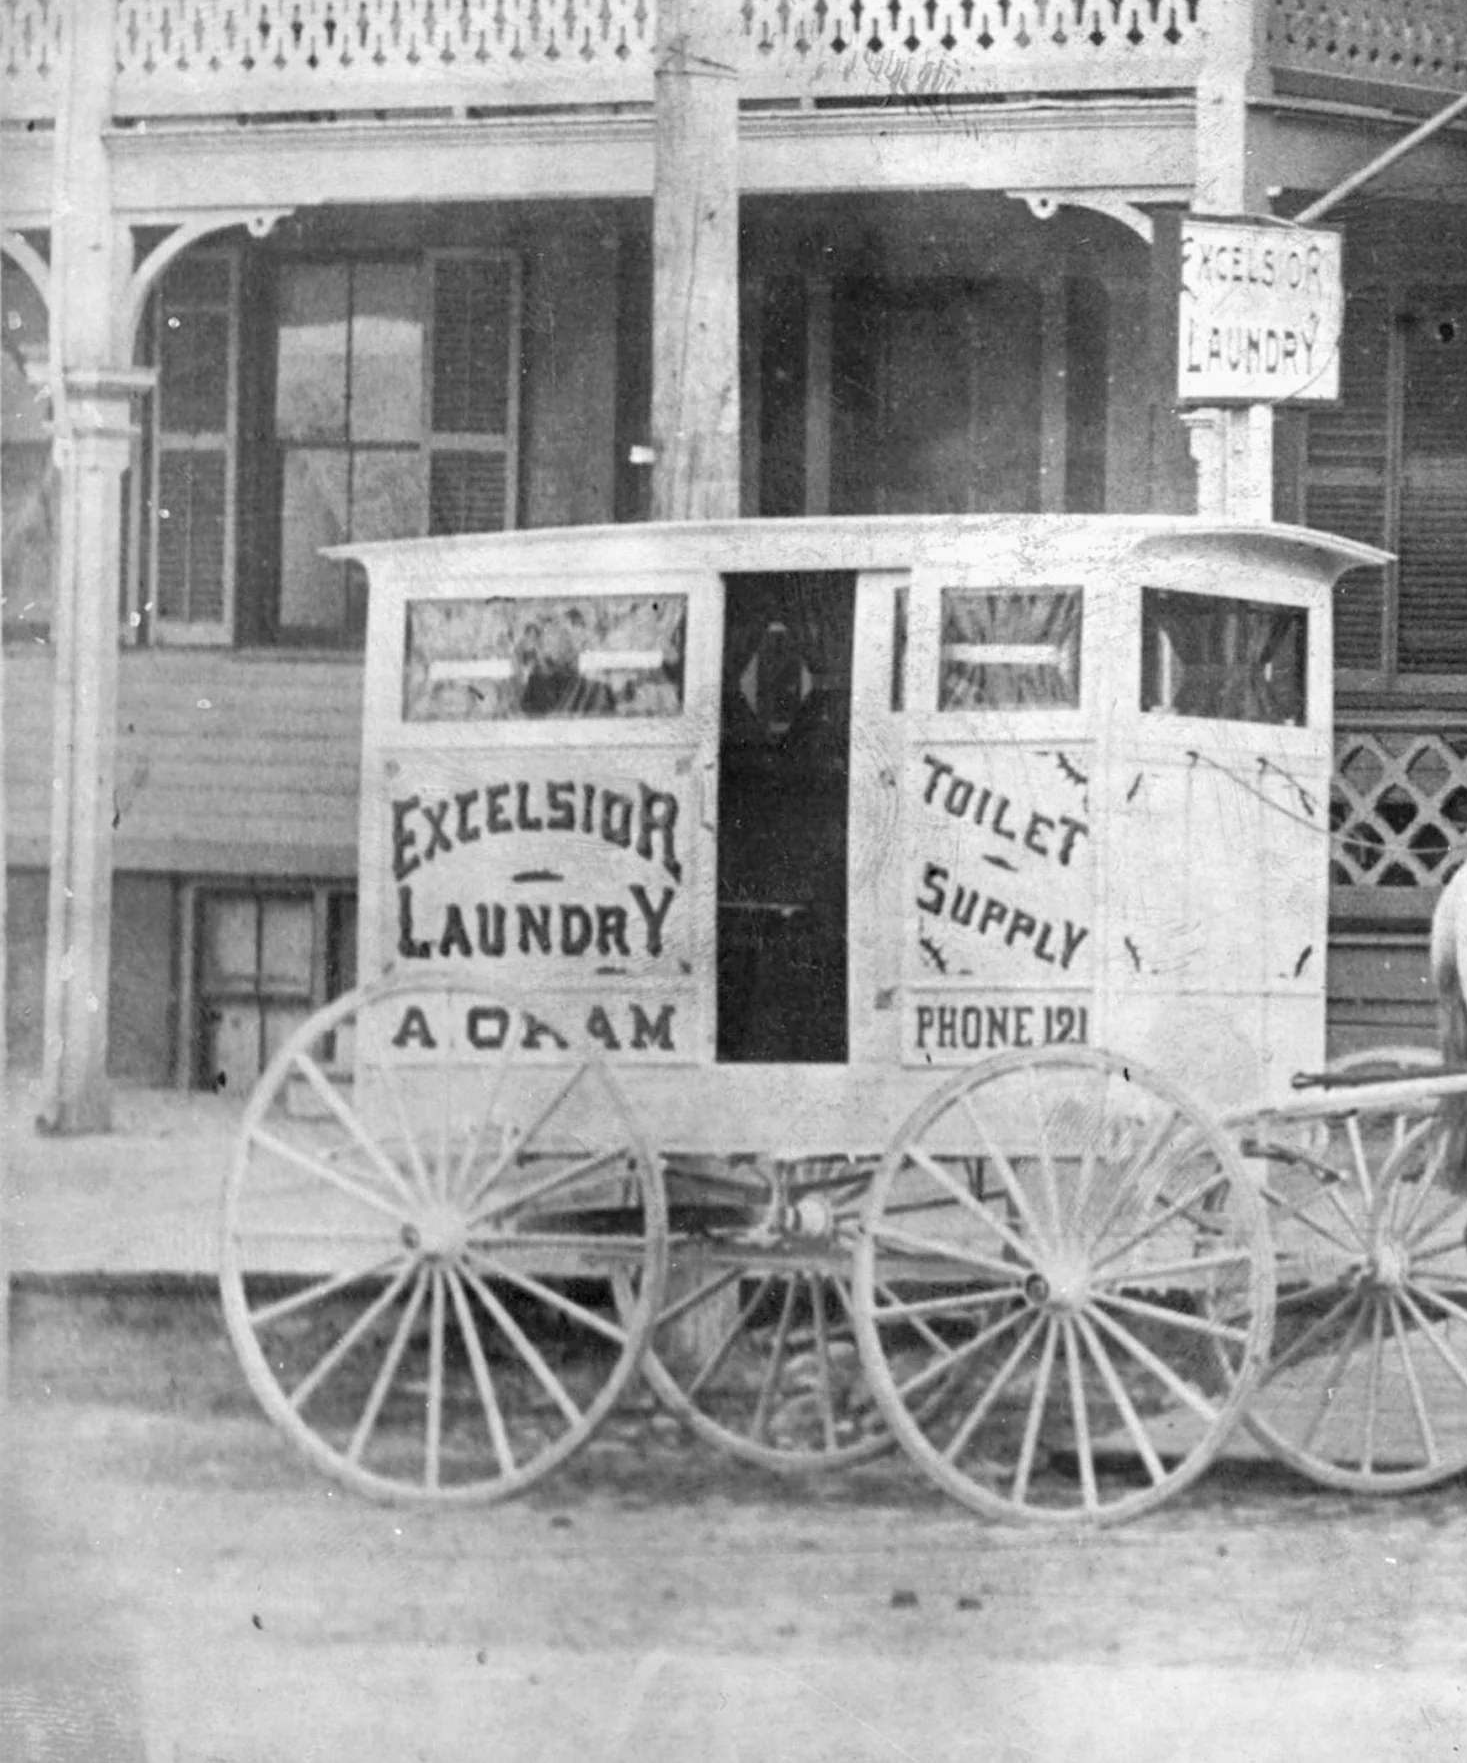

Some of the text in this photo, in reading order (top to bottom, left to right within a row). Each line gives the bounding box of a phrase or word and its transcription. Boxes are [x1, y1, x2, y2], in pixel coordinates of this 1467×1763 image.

[1187, 311, 1320, 374] LAUNDRY
[392, 781, 681, 884] EXCELSIOR
[923, 753, 1089, 867] TOILET
[398, 884, 675, 959] LAUNDRY
[916, 861, 1089, 970] SUPPLY
[916, 1005, 1088, 1049] PHONE 121
